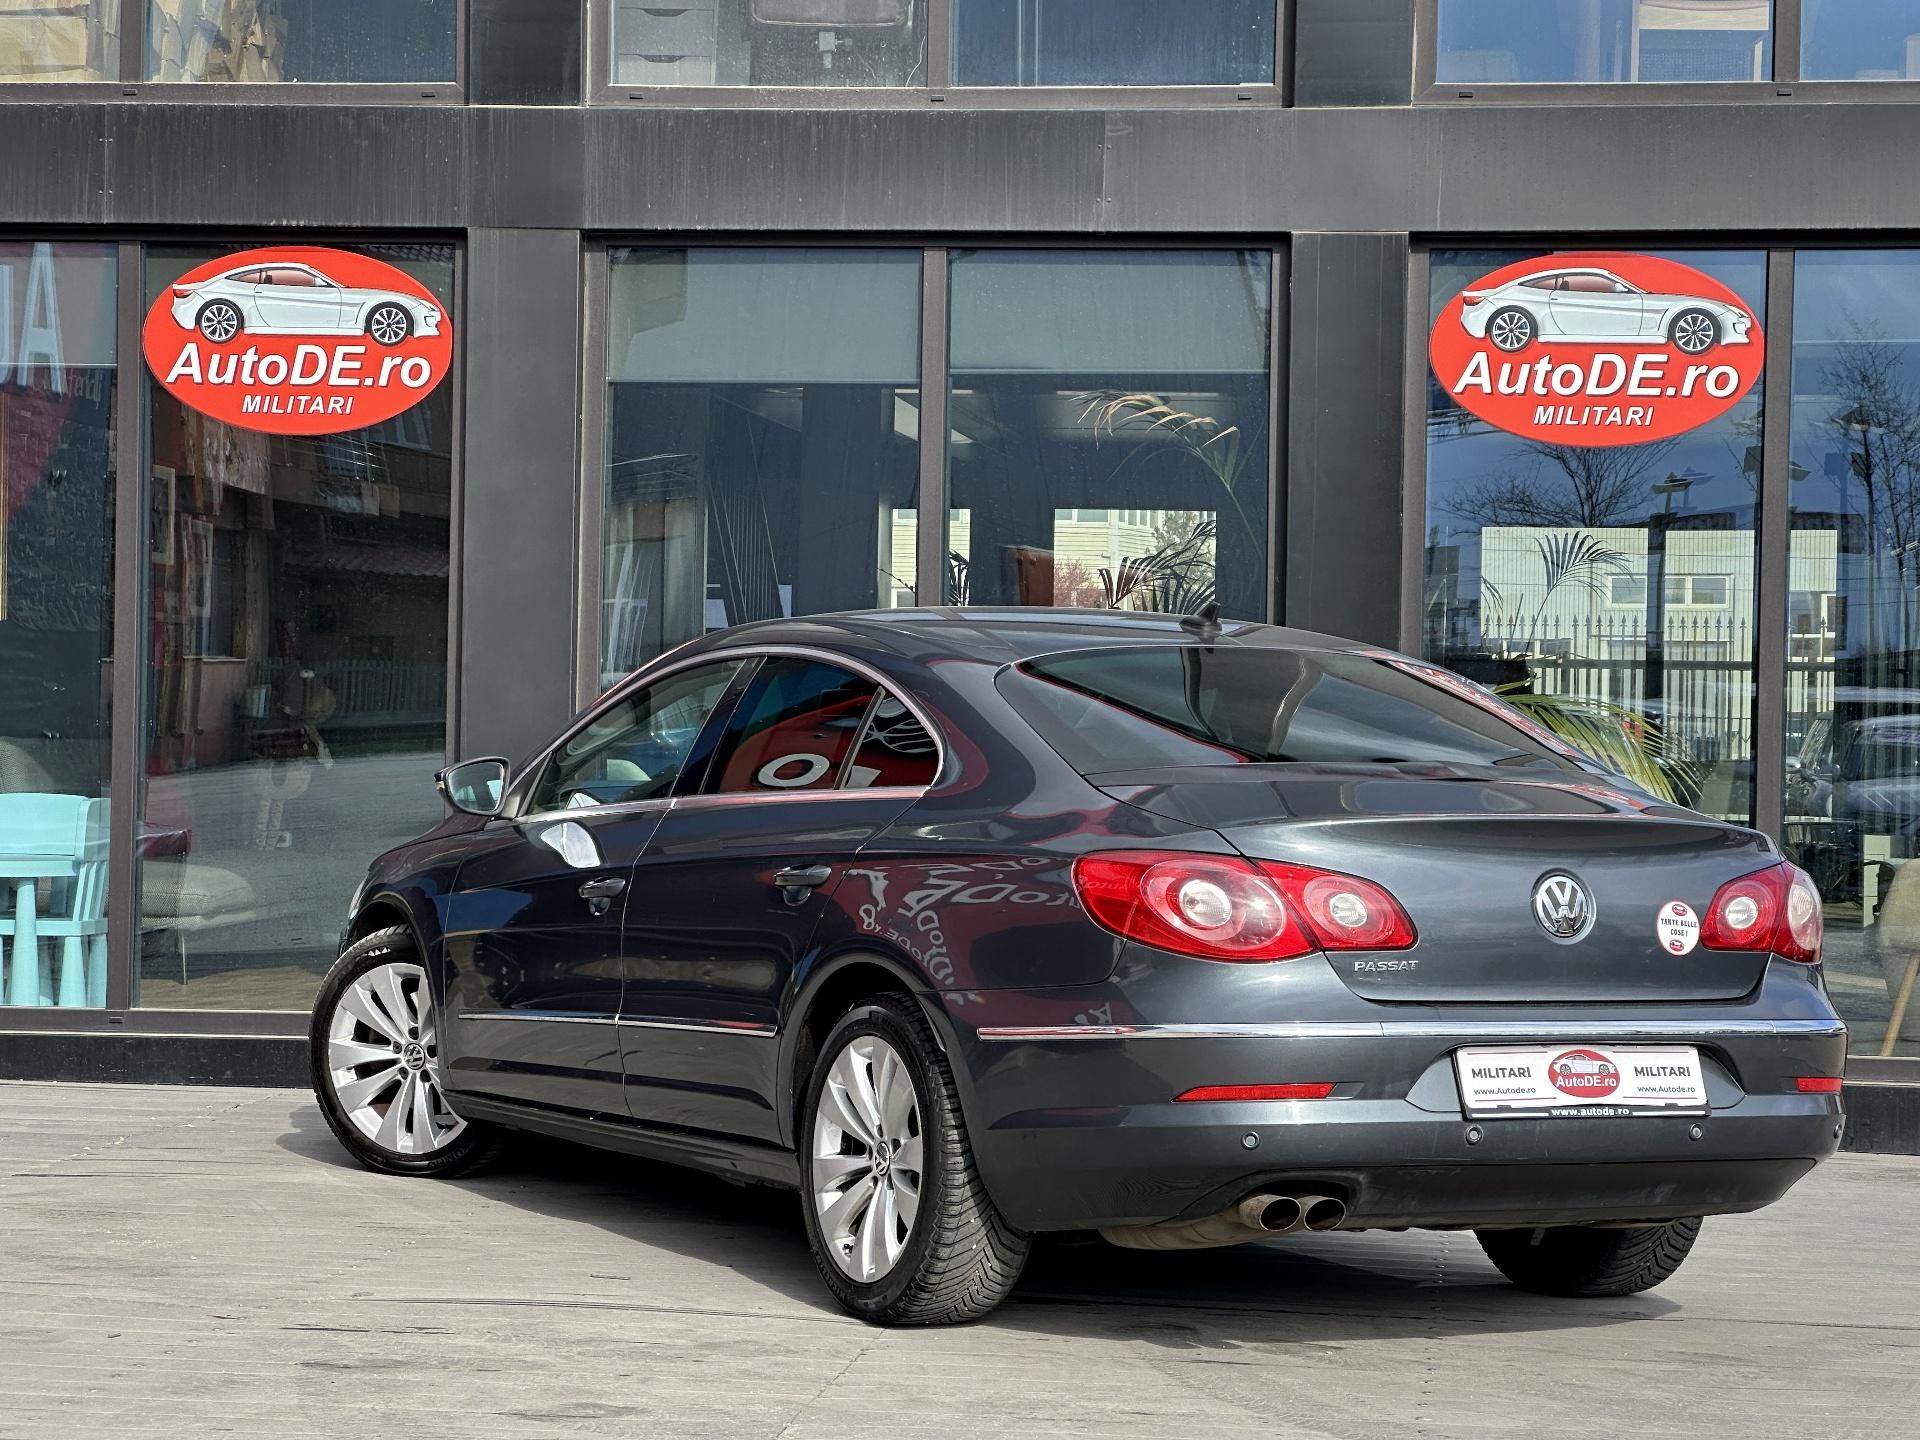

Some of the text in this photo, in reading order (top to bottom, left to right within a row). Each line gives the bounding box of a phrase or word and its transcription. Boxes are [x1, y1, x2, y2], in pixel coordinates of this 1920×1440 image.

[166, 342, 432, 389] AutoDE.ro
[1452, 351, 1740, 399] AutoDE.ro
[241, 394, 354, 415] MILITARI
[1533, 405, 1654, 427] MILITARI
[1660, 918, 1698, 928] TANTE BELLE
[1354, 960, 1419, 972] PASSAT
[1471, 1066, 1532, 1079] MILITARI
[1633, 1065, 1691, 1077] MILITARI
[1556, 1075, 1617, 1087] AutoDE.ro
[1473, 1086, 1537, 1095] www.Autode.ro
[1636, 1084, 1696, 1093] www.Autode.ro
[1550, 1106, 1630, 1116] www.autode.ro
